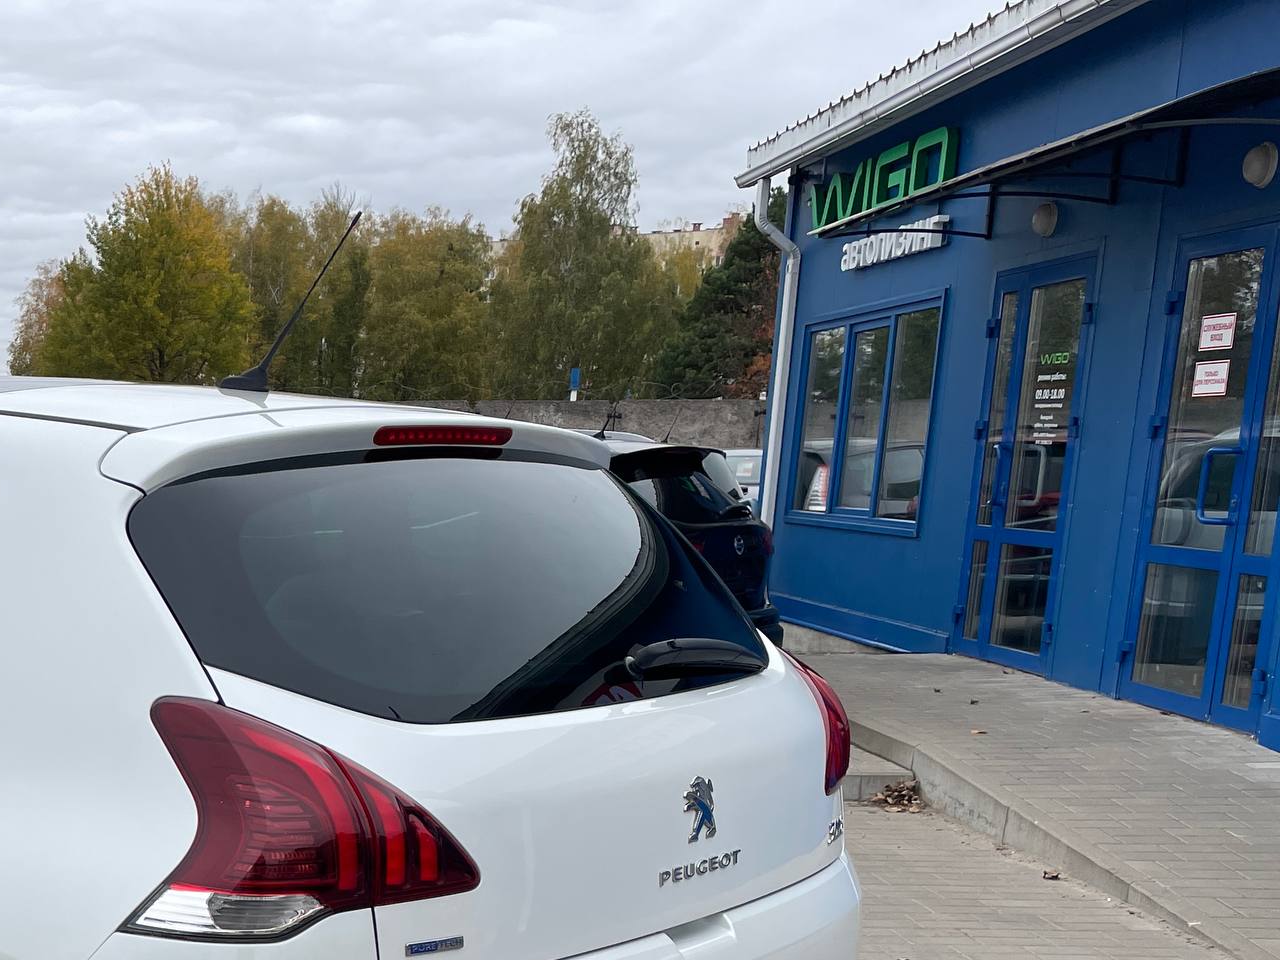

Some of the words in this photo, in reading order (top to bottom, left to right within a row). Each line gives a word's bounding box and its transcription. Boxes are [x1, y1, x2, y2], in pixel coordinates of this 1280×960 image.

[808, 126, 956, 231] WIGO
[841, 215, 950, 271] автолизинг
[1040, 352, 1070, 365] WIGO
[658, 849, 742, 887] PEUGEOT
